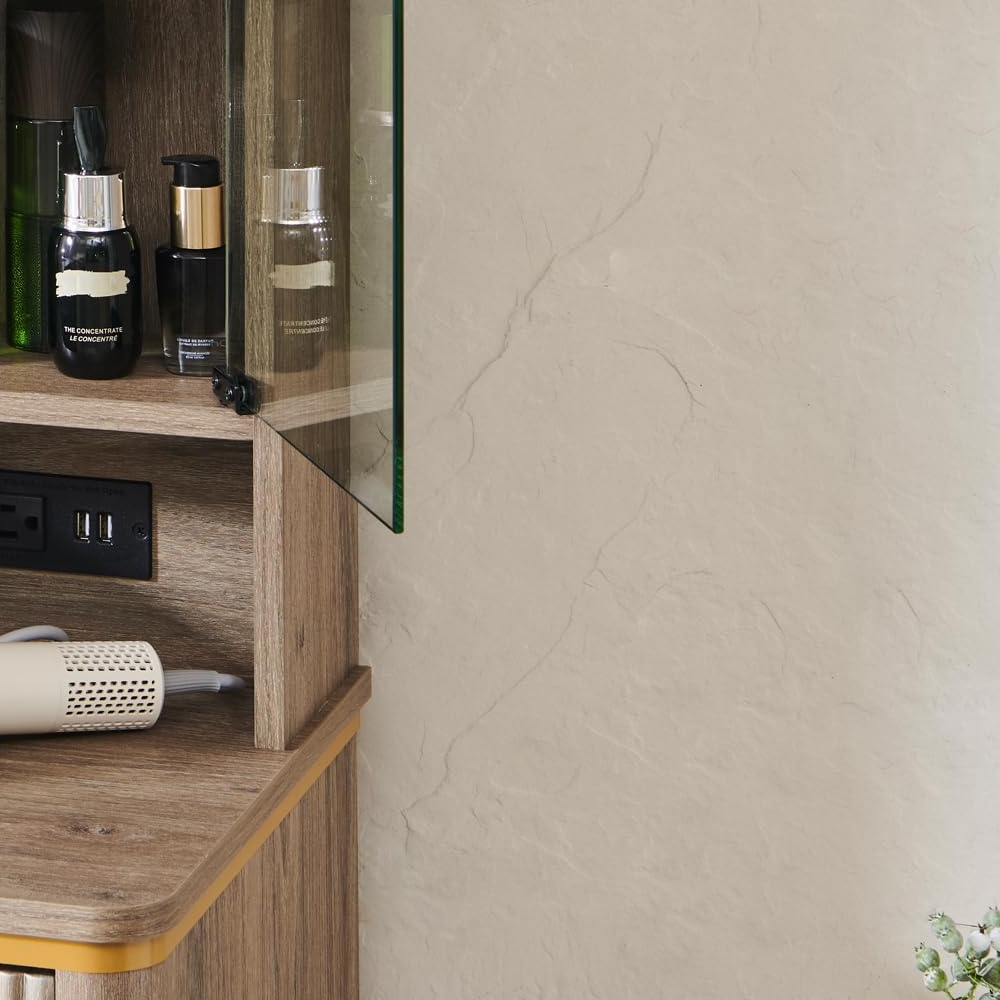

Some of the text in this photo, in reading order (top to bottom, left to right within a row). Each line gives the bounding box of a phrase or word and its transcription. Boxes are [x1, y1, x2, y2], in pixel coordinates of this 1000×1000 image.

[64, 325, 123, 335] THE CONCENTRATE
[69, 334, 118, 343] LE CONCENTRÉ
